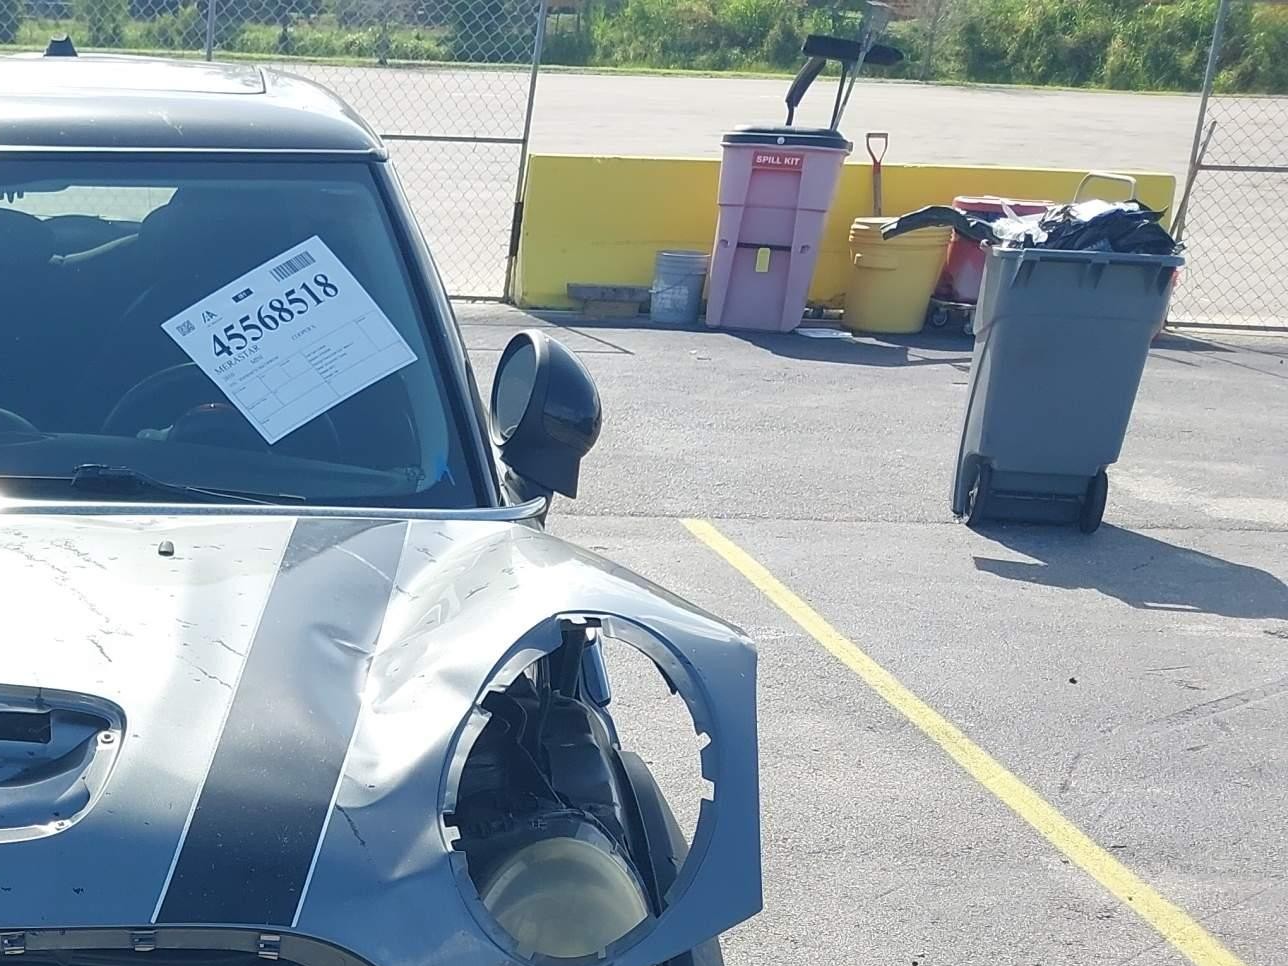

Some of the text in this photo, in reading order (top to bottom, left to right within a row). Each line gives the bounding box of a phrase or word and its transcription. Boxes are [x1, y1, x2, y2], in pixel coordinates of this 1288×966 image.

[756, 155, 801, 166] SPILL KIT
[212, 273, 339, 357] 45568518
[214, 344, 261, 375] MERASTAR
